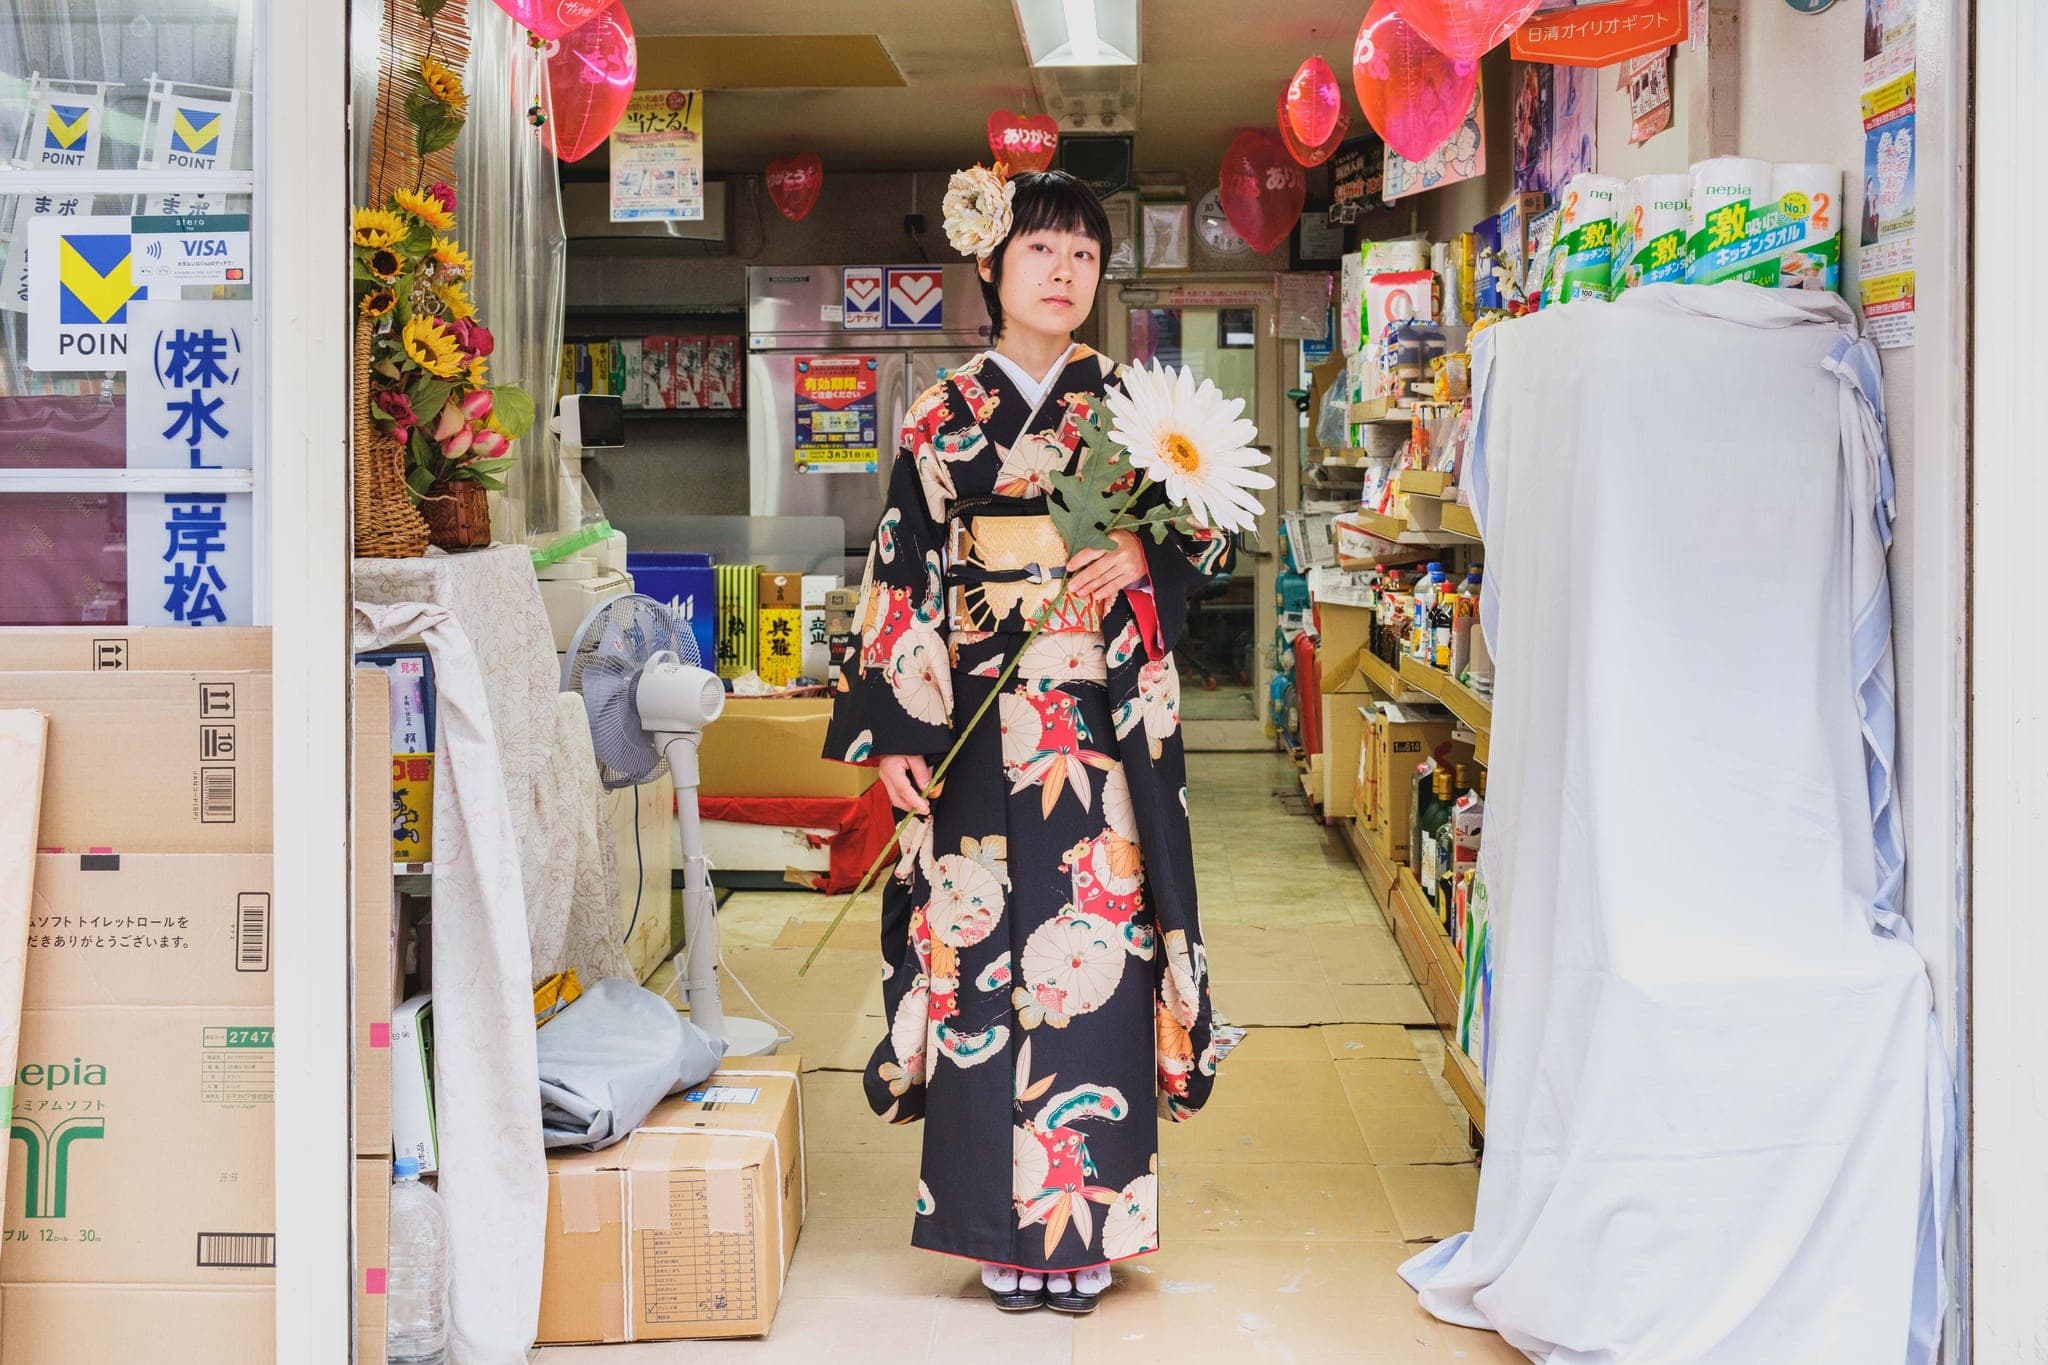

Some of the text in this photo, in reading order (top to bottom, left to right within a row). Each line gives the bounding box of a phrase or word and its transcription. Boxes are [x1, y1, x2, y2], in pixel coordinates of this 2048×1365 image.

[1528, 11, 1669, 43] 日清オイリオギフト
[42, 152, 85, 167] POINT
[168, 153, 216, 170] POINT
[1706, 183, 1752, 197] nepia
[1564, 191, 1578, 216] 2
[1654, 199, 1688, 212] nepi
[1783, 202, 1807, 214] No.1
[1812, 191, 1830, 222] 2
[175, 218, 205, 226] stera
[1634, 204, 1644, 233] 2
[180, 240, 228, 257] VISA
[1716, 226, 1801, 266] キッチンタオル
[59, 333, 127, 356] POIN
[154, 327, 241, 627] (株)水上岸松
[400, 662, 420, 674] 見本
[217, 732, 234, 753] 10
[79, 915, 189, 929] トイレットロールを
[27, 934, 189, 949] だきありがとうございます。
[229, 1031, 275, 1044] 2747
[14, 1057, 107, 1091] epia
